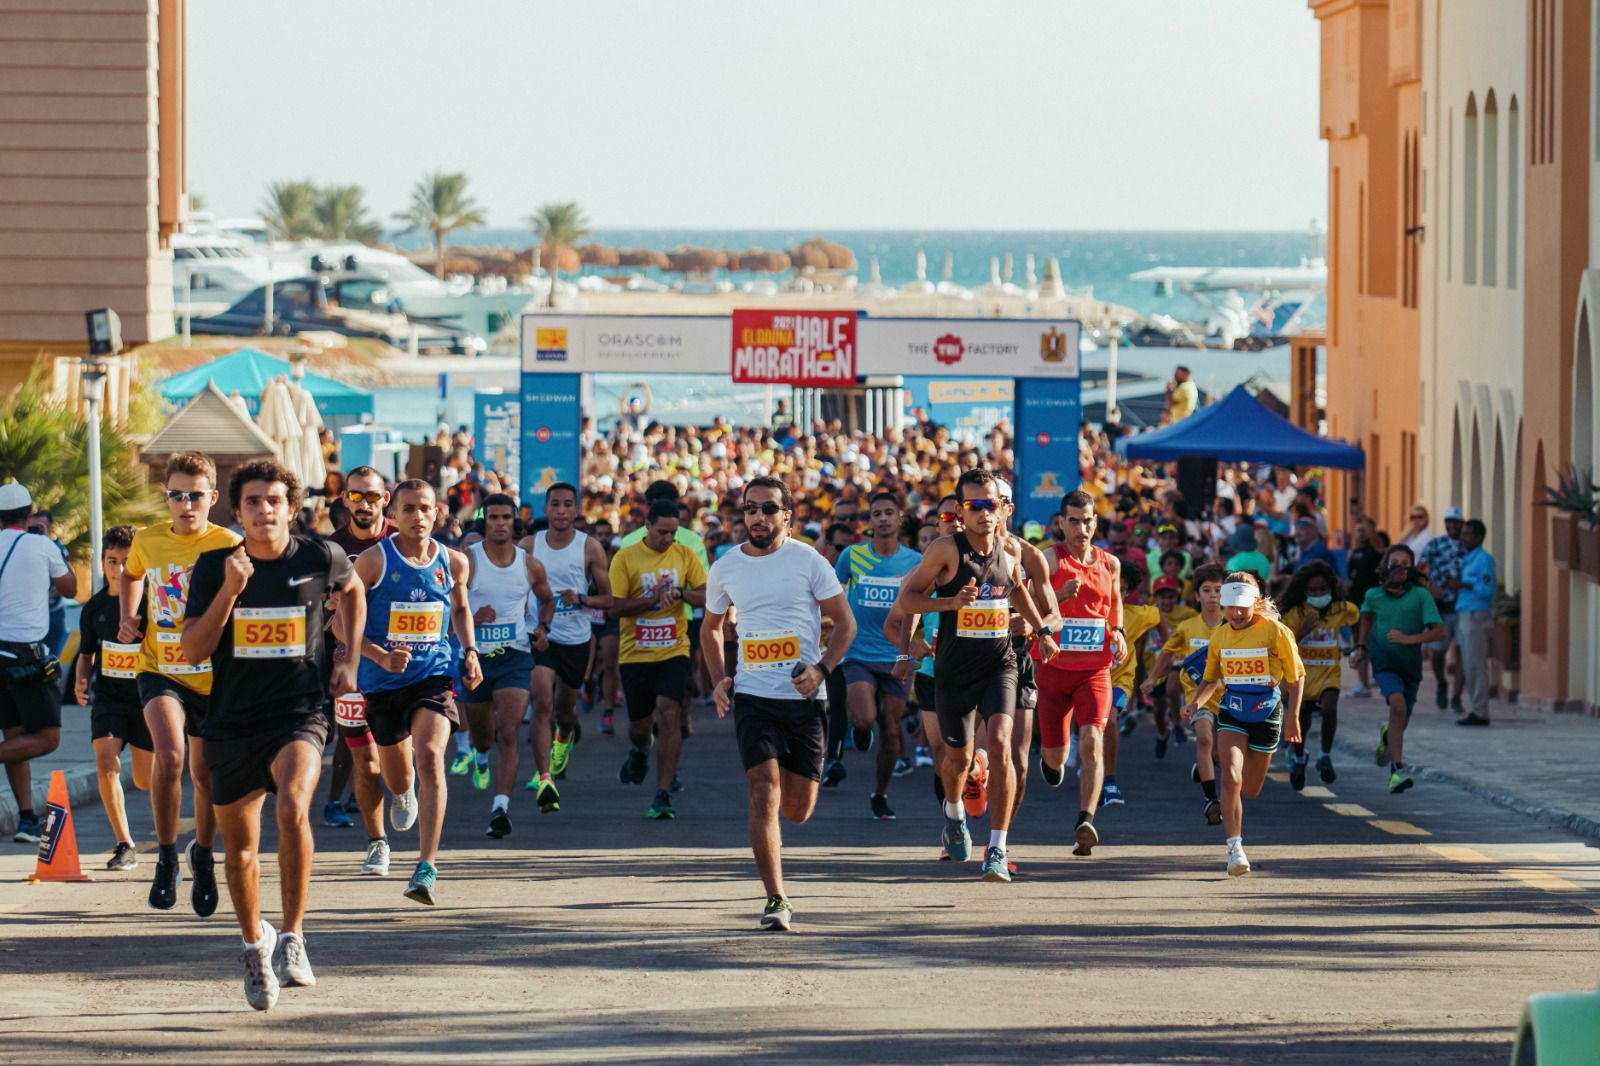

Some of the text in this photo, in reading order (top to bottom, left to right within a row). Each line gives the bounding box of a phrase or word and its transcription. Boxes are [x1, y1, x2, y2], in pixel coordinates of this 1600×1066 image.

[759, 328, 794, 346] GOUNA
[795, 315, 850, 351] HALF
[908, 343, 929, 354] THE
[968, 343, 1019, 355] FACTORY
[735, 344, 852, 379] MARATHON
[864, 586, 895, 600] 1001
[397, 615, 437, 631] 5186
[963, 612, 1006, 628] 5048
[245, 623, 297, 643] 5251
[480, 626, 511, 640] 1188
[641, 626, 672, 640] 2122
[1066, 628, 1100, 642] 1224
[746, 641, 796, 660] 5090
[1226, 659, 1265, 675] 5238
[335, 702, 364, 718] 012
